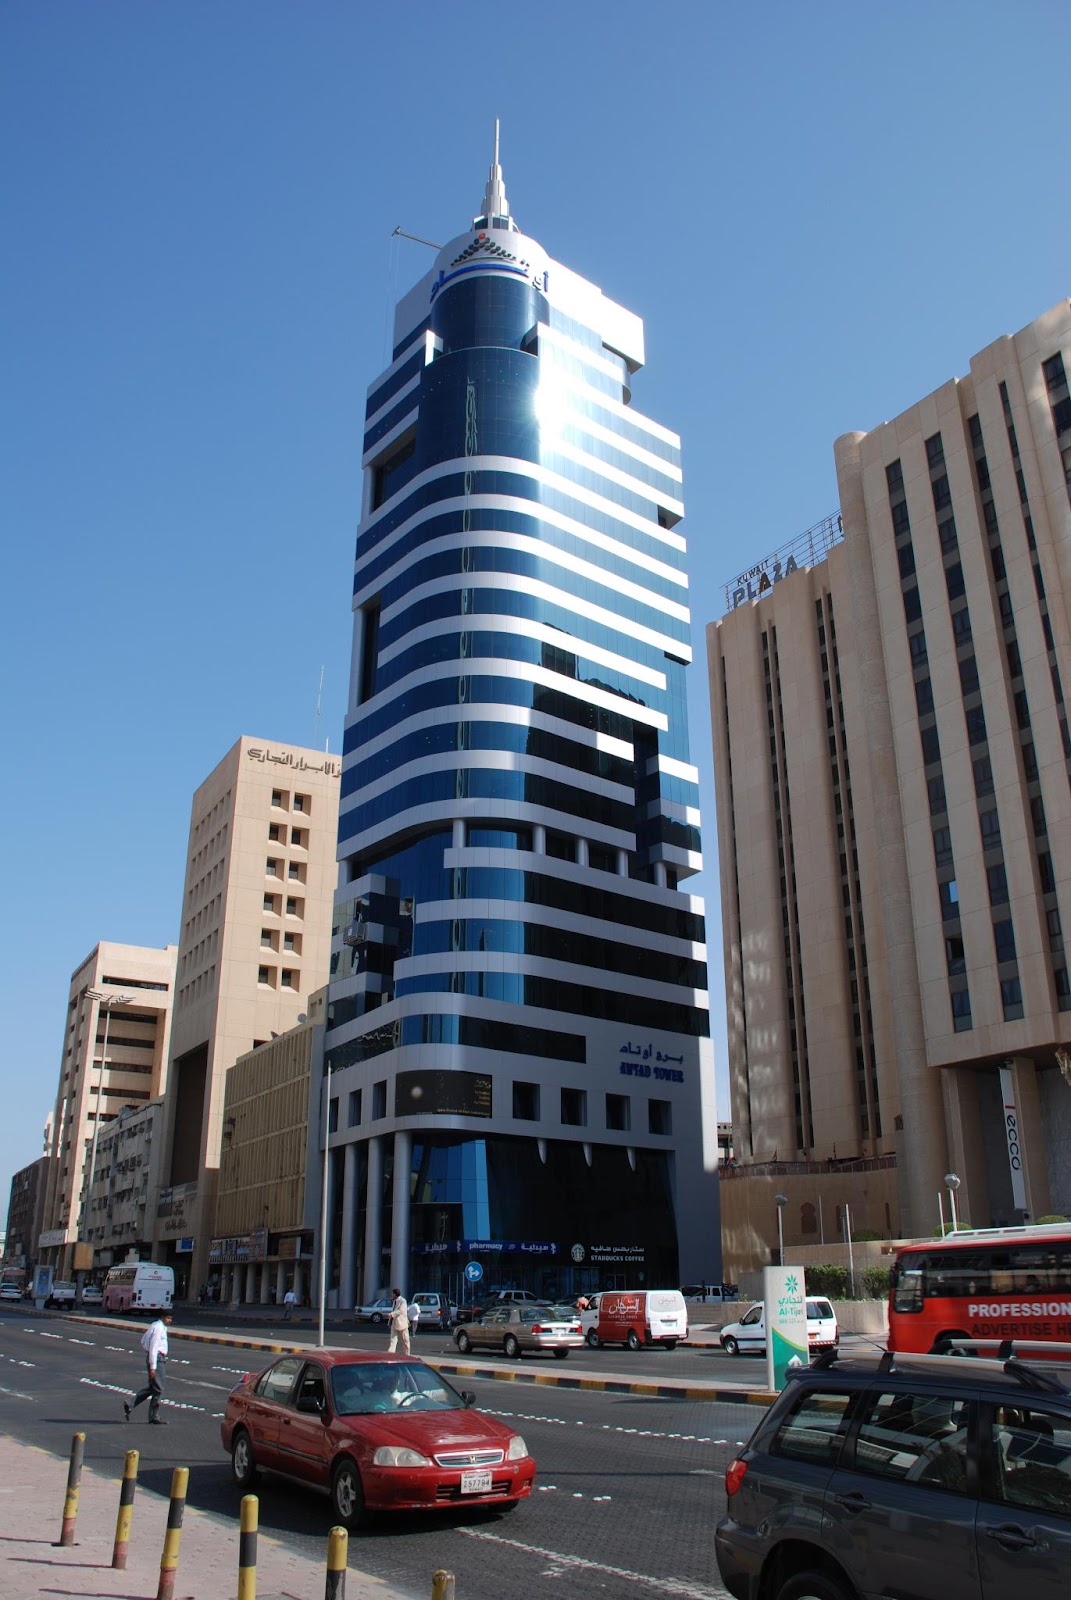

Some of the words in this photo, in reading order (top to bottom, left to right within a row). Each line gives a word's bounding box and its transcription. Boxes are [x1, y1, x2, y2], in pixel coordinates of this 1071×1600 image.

[732, 554, 798, 608] PLAZA
[737, 559, 769, 586] KUWAIT
[1006, 1114, 1020, 1171] ecco
[469, 1242, 503, 1250] pharmacy
[968, 1302, 1071, 1317] PROFESSION
[971, 1322, 1052, 1336] ADVERTISE
